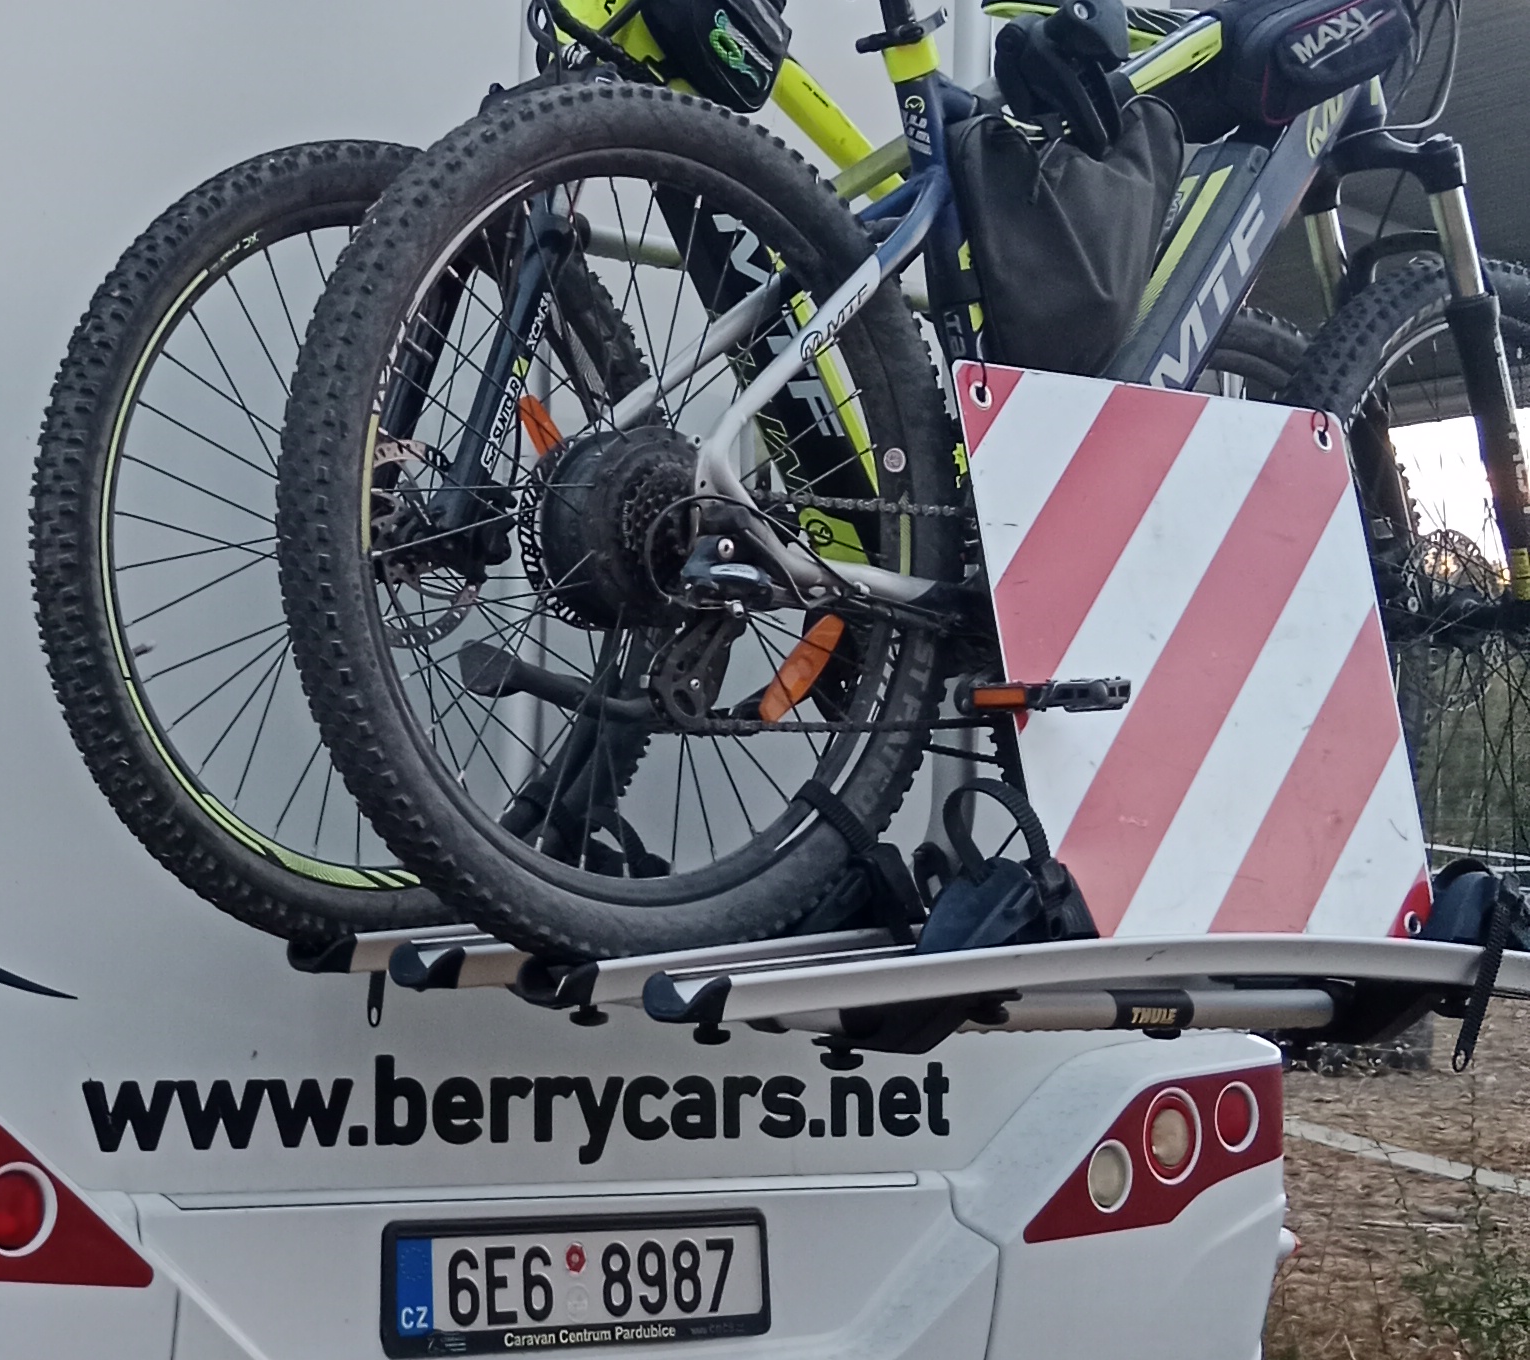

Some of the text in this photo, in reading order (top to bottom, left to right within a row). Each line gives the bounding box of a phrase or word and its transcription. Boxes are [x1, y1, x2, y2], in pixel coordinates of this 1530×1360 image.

[1148, 191, 1266, 390] MTF
[1131, 1006, 1178, 1025] THULE
[81, 1054, 951, 1165] www.berrycars.net
[401, 1237, 735, 1330] CZ 6E6 8987
[503, 1332, 557, 1348] Caravan
[559, 1328, 612, 1344] Centrum
[615, 1323, 677, 1341] Pardubice
